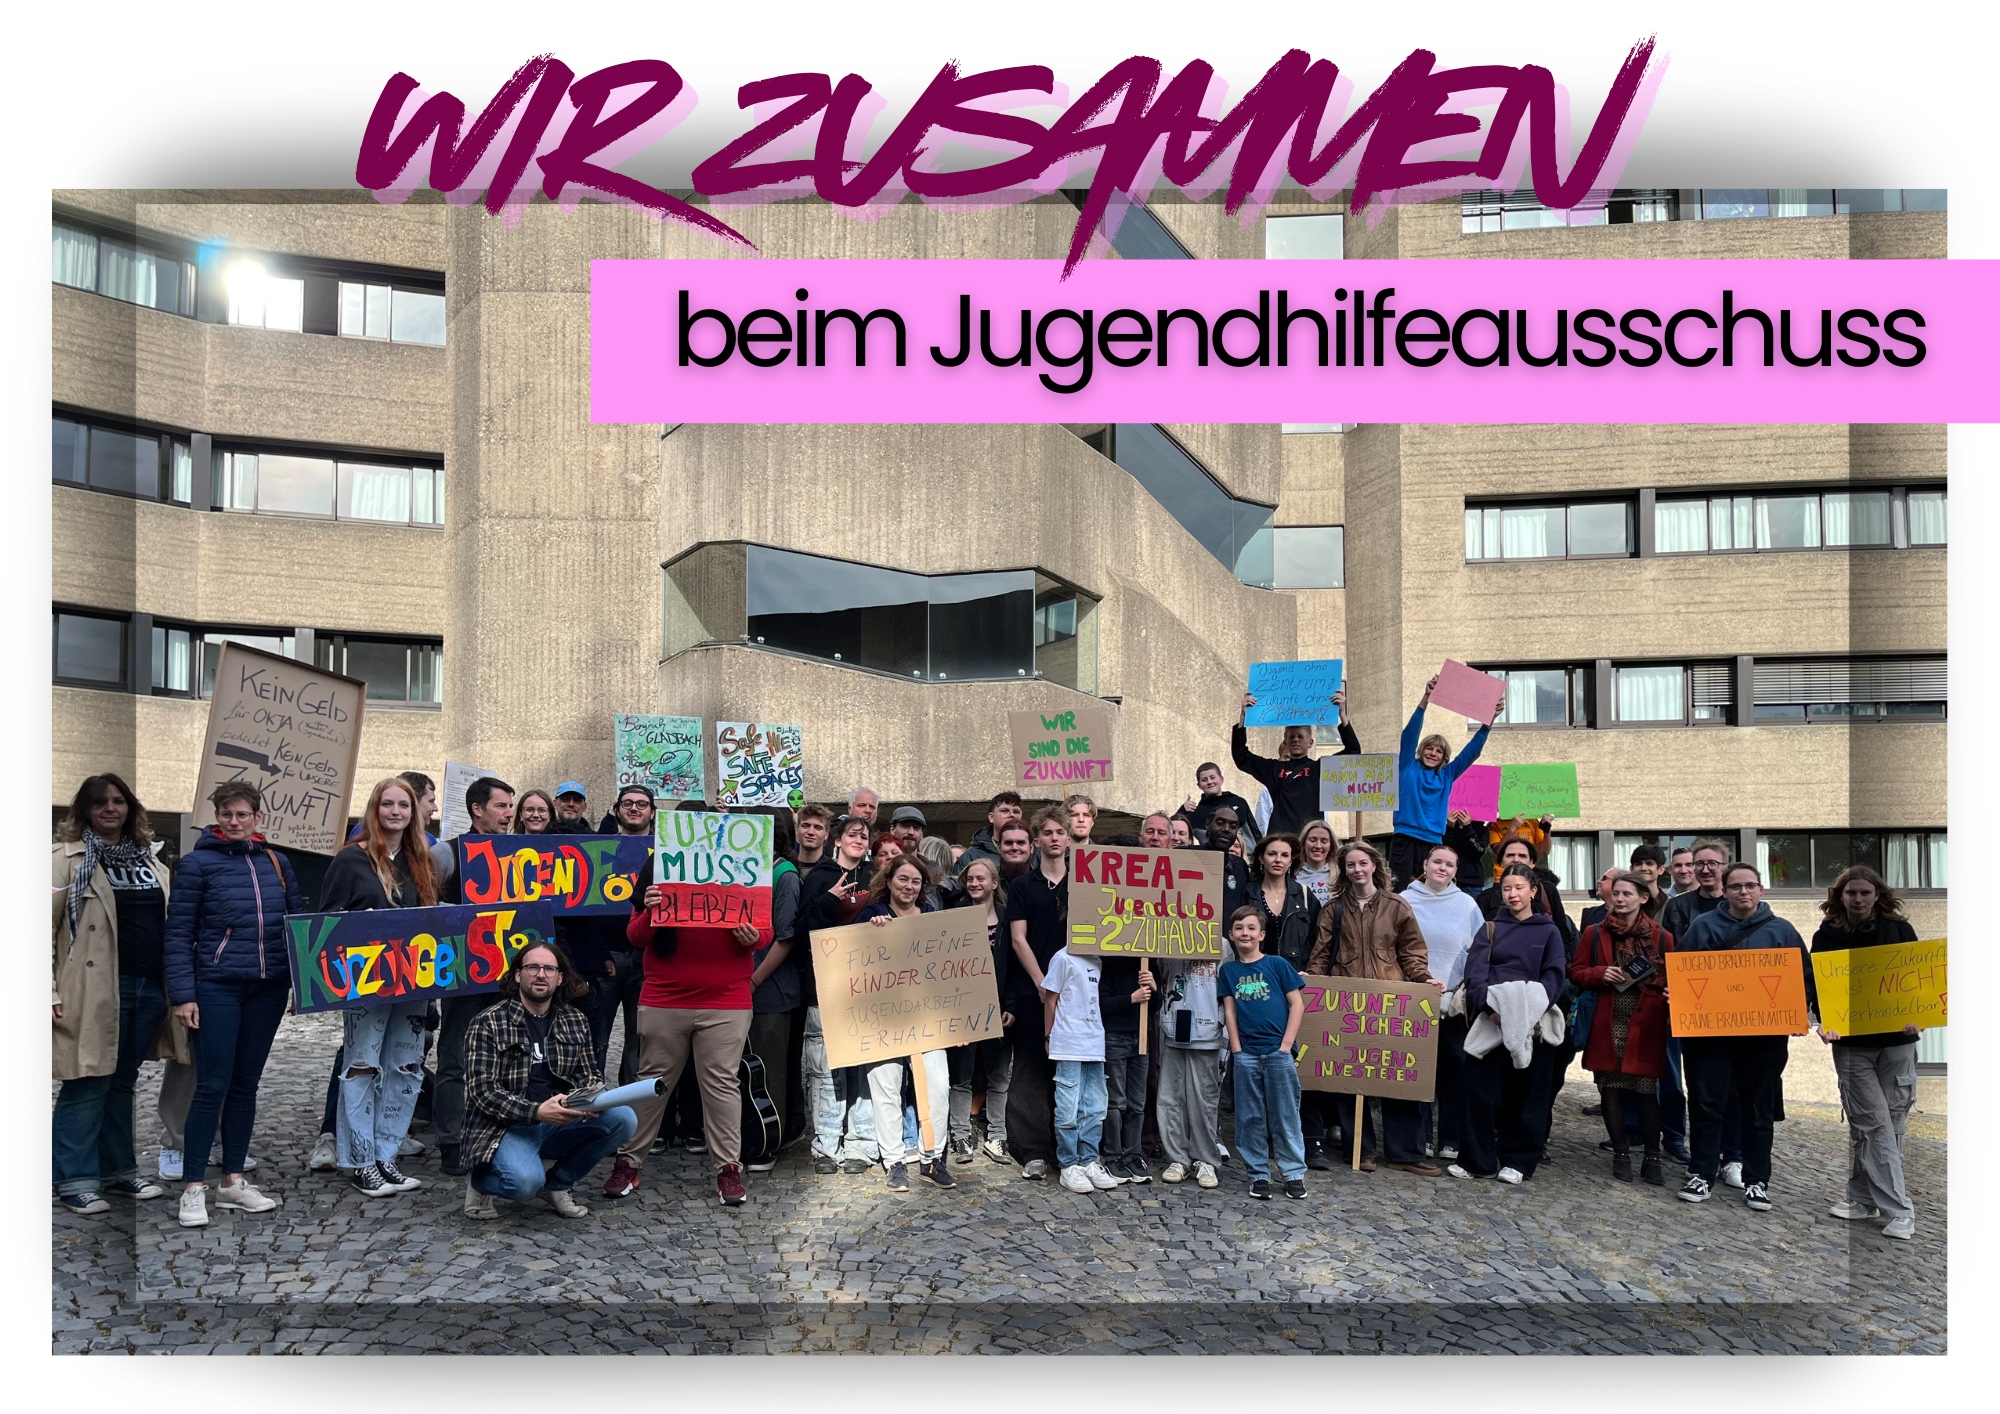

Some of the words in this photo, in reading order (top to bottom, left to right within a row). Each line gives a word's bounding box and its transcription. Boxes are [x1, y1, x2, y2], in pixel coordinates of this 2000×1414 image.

[1040, 711, 1077, 732] WIR
[646, 731, 702, 748] GLADBACH
[719, 723, 762, 758] Safe
[1028, 740, 1060, 759] SIND
[1066, 736, 1091, 755] DIE
[727, 751, 775, 779] SAFE
[1023, 760, 1111, 780] ZUKUNFT
[1339, 755, 1394, 769] JUGEND
[620, 770, 638, 785] Q1
[740, 764, 803, 797] SPACES
[1322, 769, 1357, 783] KANN
[1364, 768, 1393, 783] MAN
[207, 763, 340, 826] ZKUNFT
[725, 793, 739, 804] Q1
[1347, 781, 1384, 795] NICHT
[1333, 791, 1396, 808] SKIPPEN
[662, 851, 760, 887] MUSS
[1097, 887, 1214, 925] Jugendclub
[846, 945, 891, 971] FÜR
[1677, 955, 1716, 972] JUGEND
[1718, 953, 1757, 970] BRAUCHT
[924, 962, 937, 981] &
[940, 957, 992, 981] ENKEL
[1819, 960, 1878, 978] Unsere
[1845, 978, 1863, 995] ist
[1878, 964, 1947, 995] NICHT
[1726, 984, 1744, 992] UND
[845, 987, 972, 1036] JUGENDARBEIT
[1302, 987, 1411, 1016] ZUKUNFT
[860, 1003, 996, 1052] ERHALTEN!
[1716, 1010, 1765, 1028] BRAUCHEN
[1765, 1009, 1801, 1027] MITTEL
[1322, 1031, 1341, 1046] IN
[1344, 1047, 1416, 1068] JUGEND
